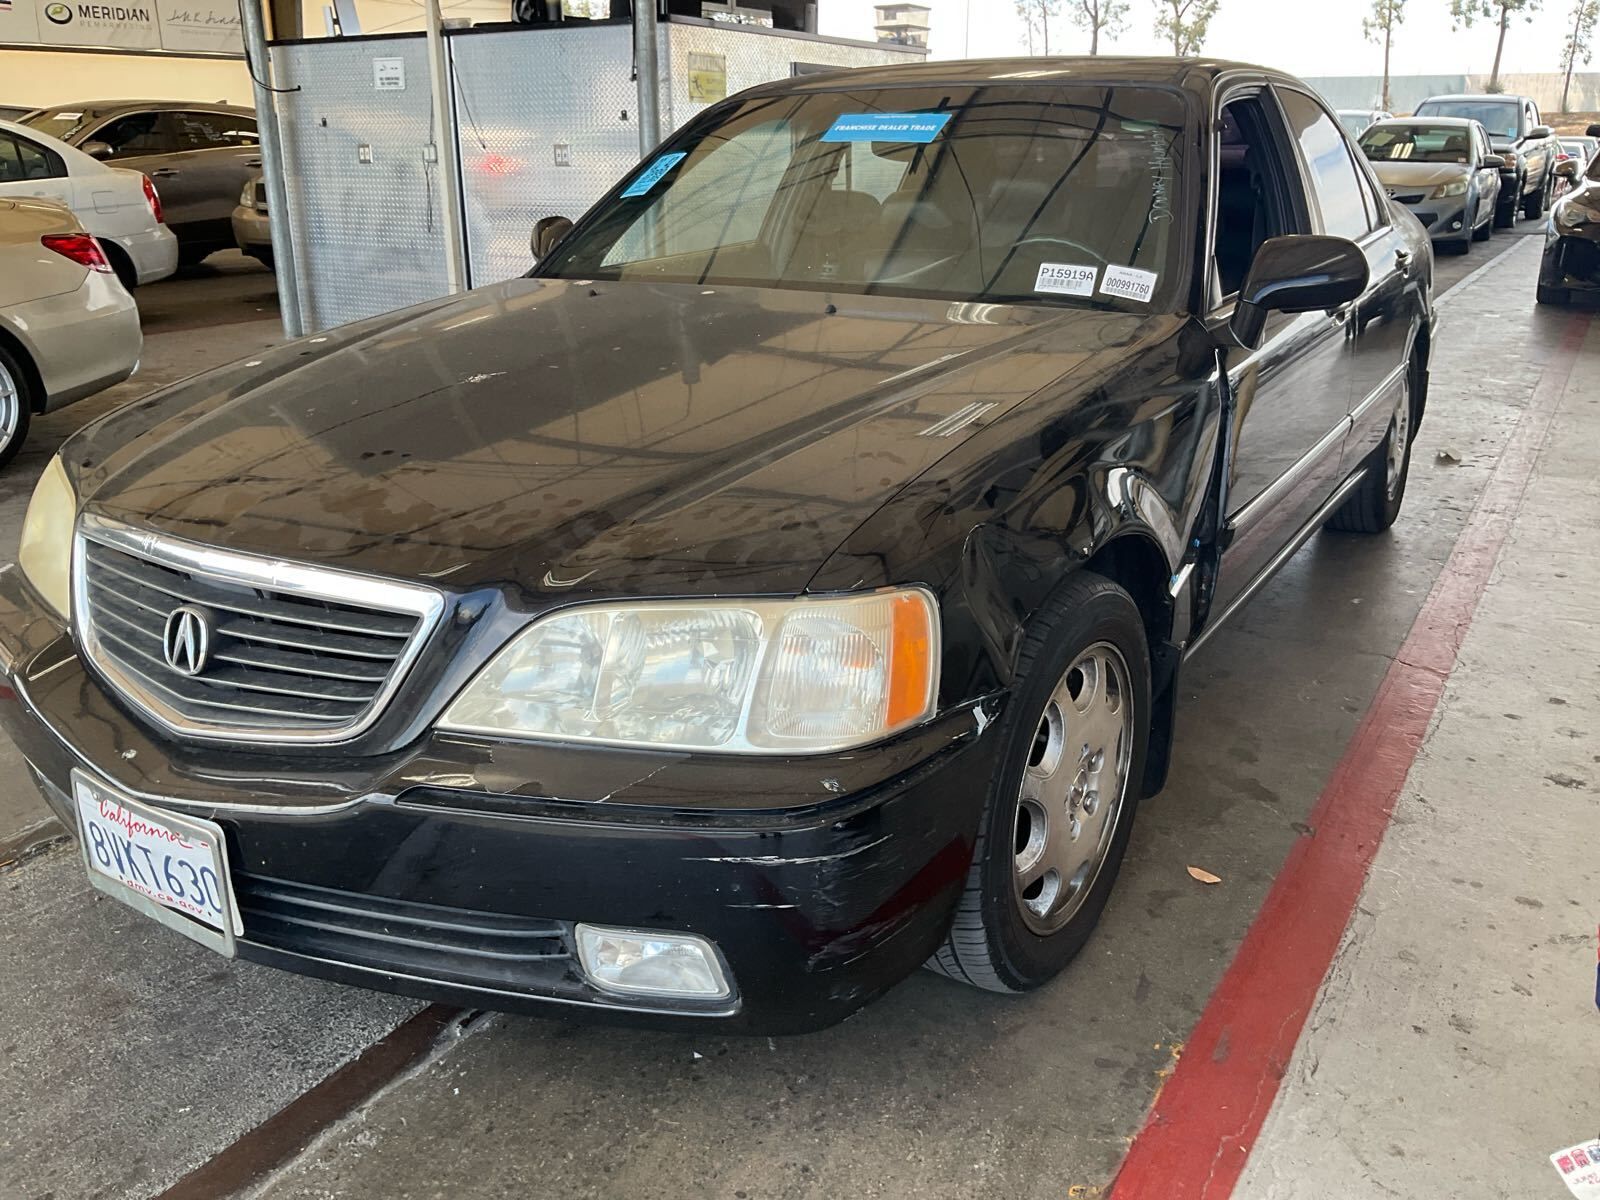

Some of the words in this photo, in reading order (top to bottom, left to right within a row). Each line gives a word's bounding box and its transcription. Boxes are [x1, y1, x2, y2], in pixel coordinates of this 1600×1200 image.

[78, 5, 150, 22] MERIDIAN
[1040, 267, 1094, 281] P15919A
[1106, 277, 1150, 295] 000991760
[100, 799, 193, 849] California
[89, 821, 222, 914] 8VKT630
